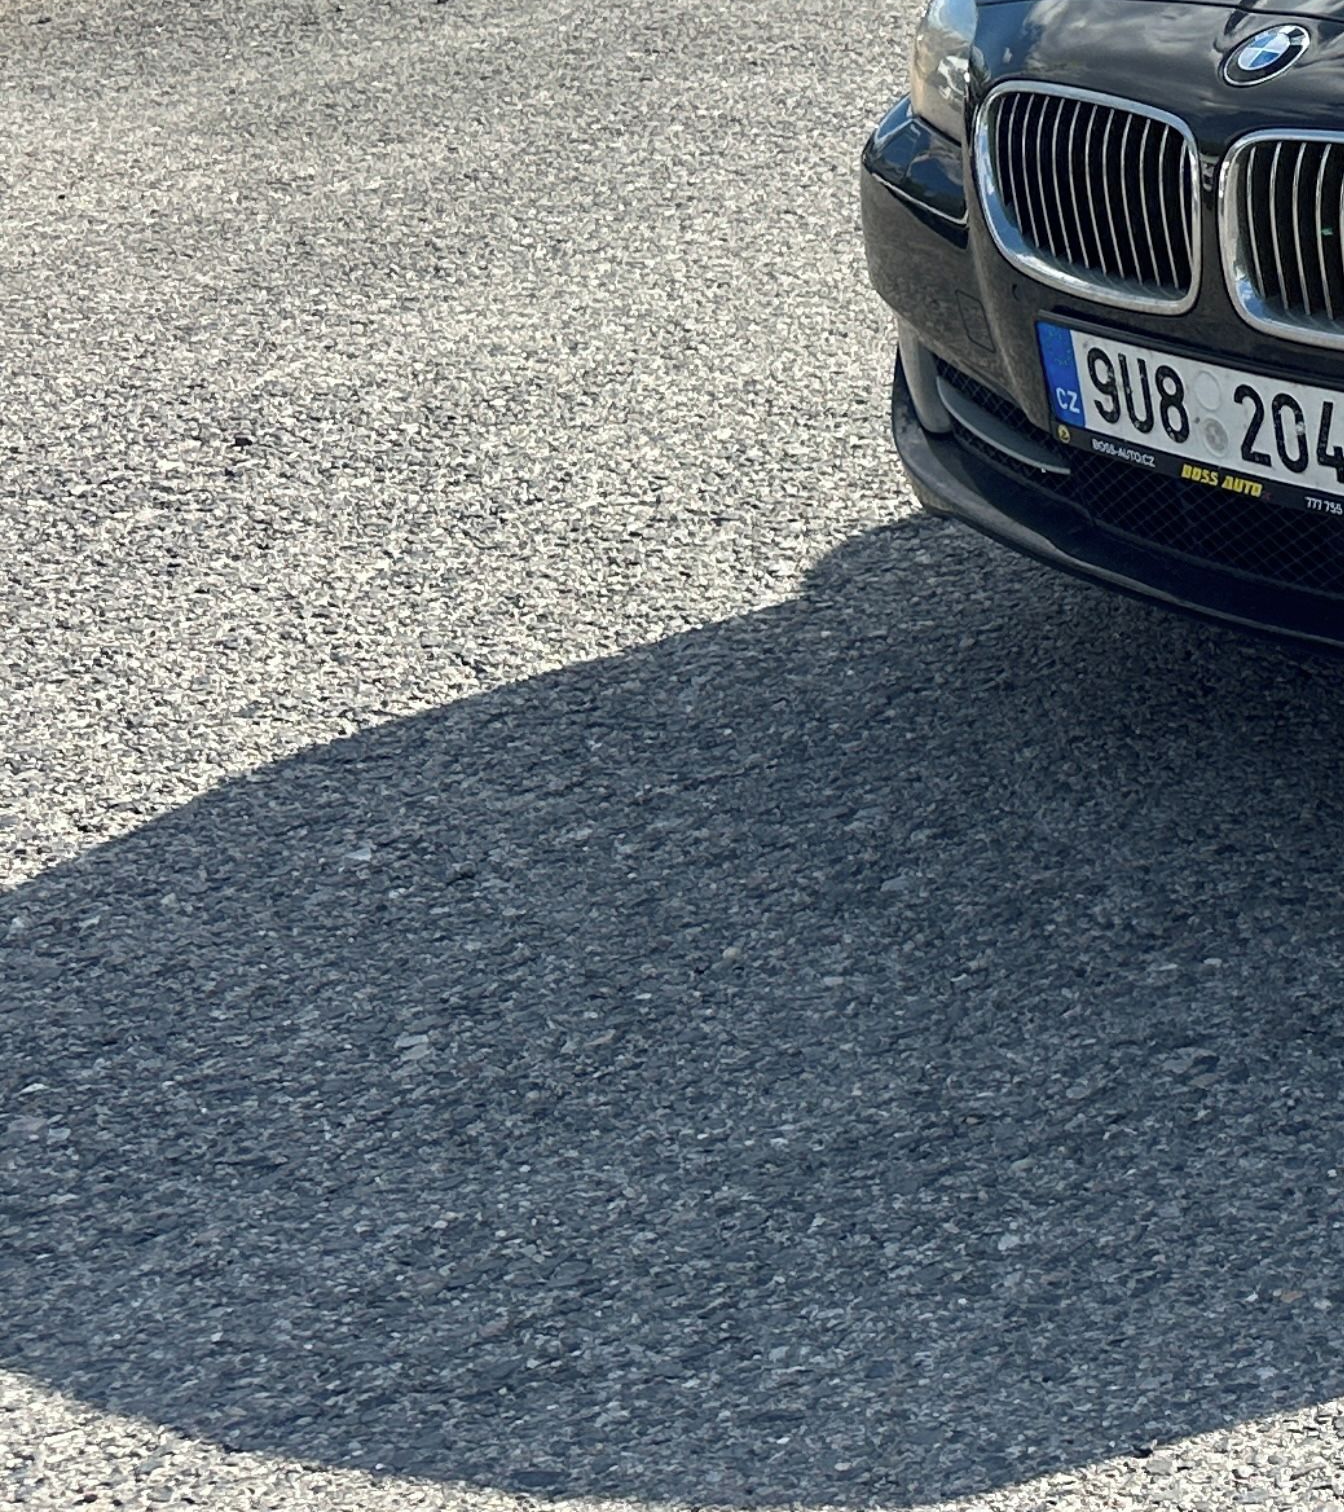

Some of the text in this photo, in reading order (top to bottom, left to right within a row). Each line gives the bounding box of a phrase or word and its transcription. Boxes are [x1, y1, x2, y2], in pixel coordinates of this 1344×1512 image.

[1055, 387, 1081, 415] CZ
[1086, 347, 1191, 445] 9U8
[1180, 463, 1263, 498] BOSS AUTO
